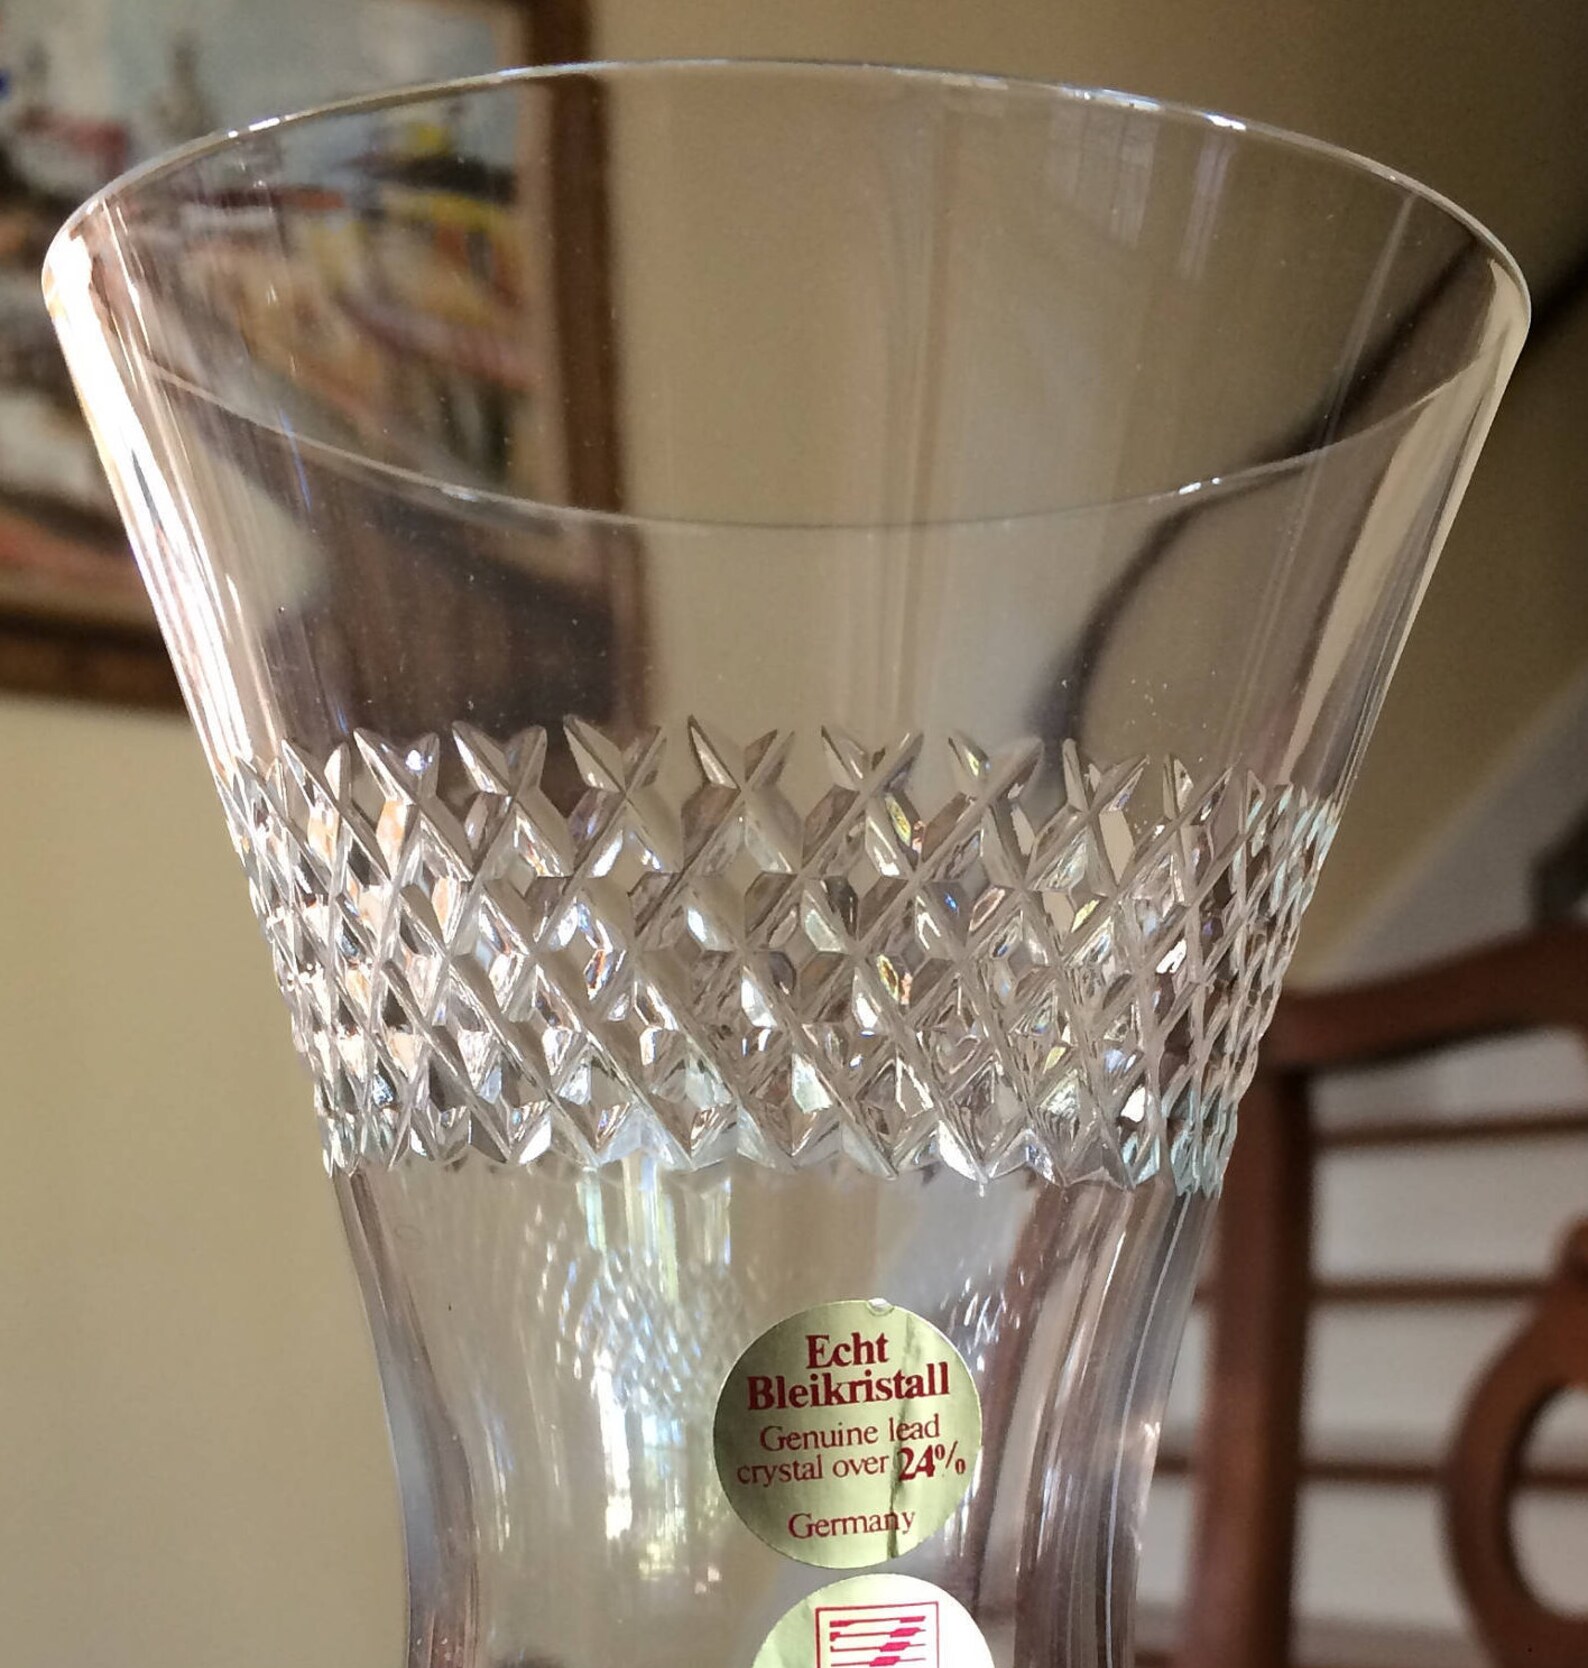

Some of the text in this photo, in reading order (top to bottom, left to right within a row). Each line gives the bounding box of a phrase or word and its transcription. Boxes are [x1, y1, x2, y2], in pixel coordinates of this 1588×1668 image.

[805, 1331, 889, 1369] Echt
[747, 1361, 950, 1410] Bleikristall
[759, 1413, 940, 1452] Genuine lead
[737, 1440, 967, 1487] crystal over 24%
[787, 1511, 916, 1540] Germany
